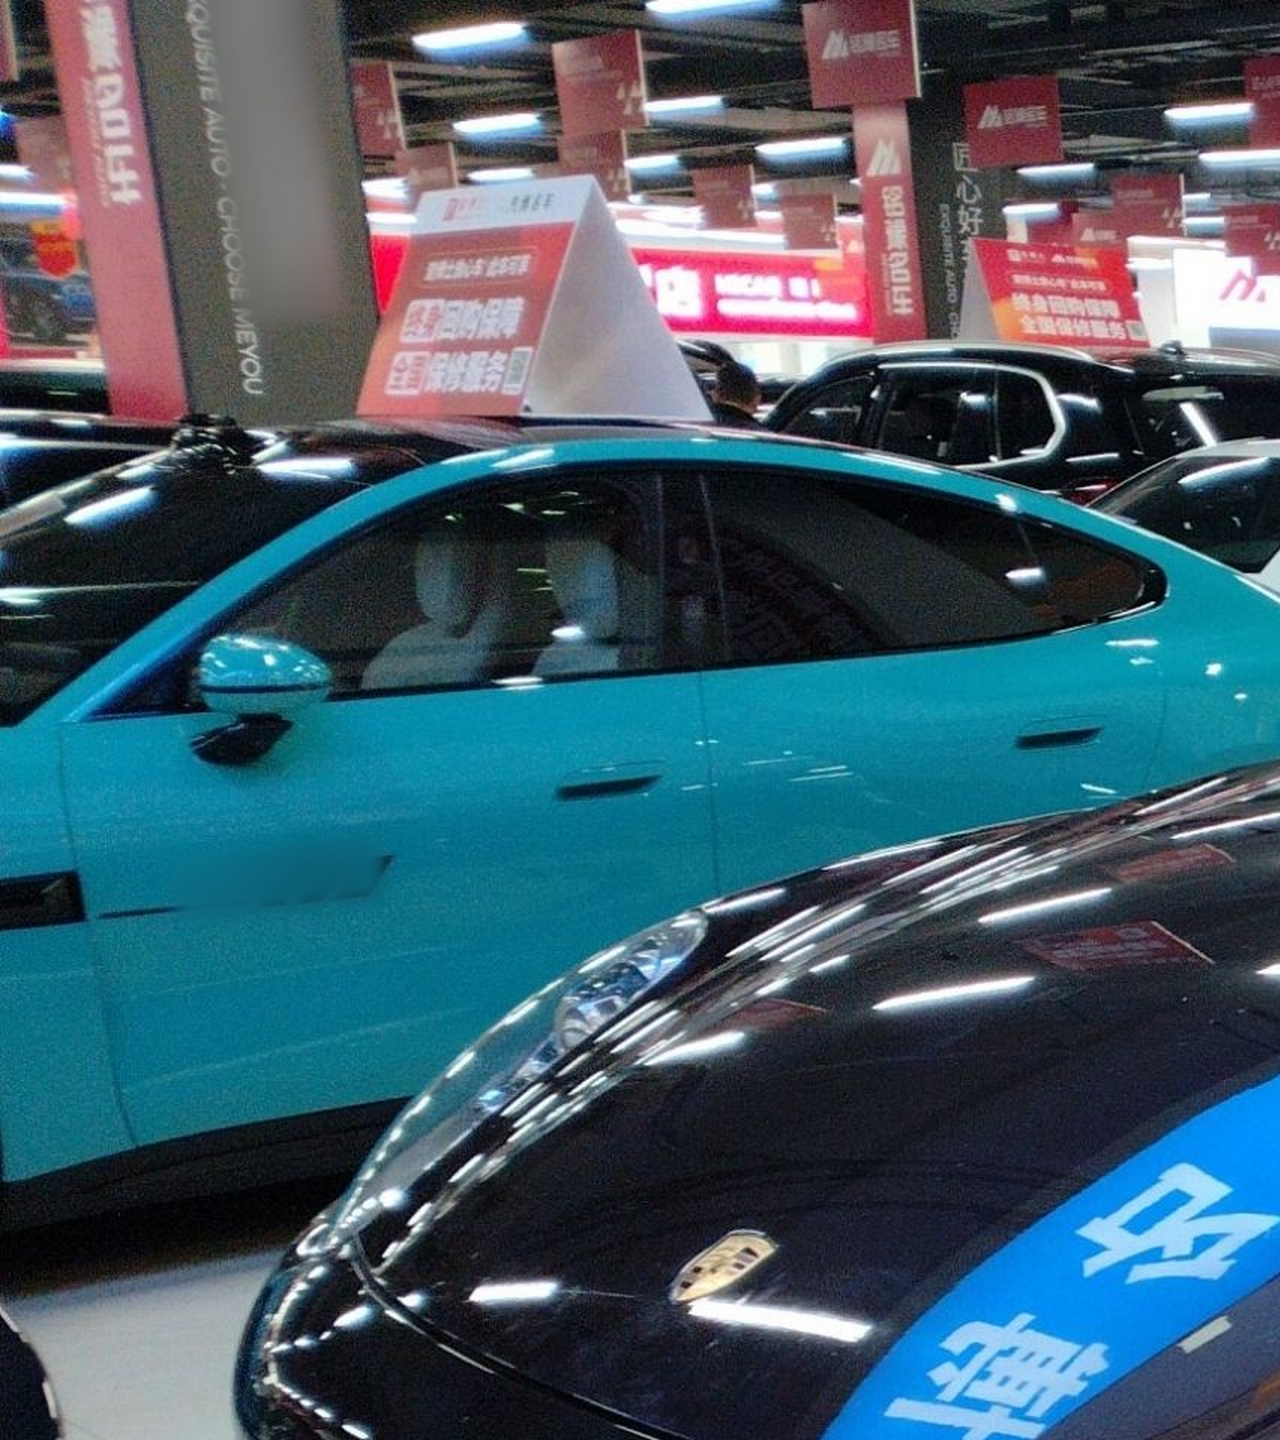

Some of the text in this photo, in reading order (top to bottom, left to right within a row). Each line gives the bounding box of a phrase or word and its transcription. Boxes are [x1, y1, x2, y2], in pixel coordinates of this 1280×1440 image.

[184, 0, 222, 103] QUISITE
[202, 110, 232, 178] AUTO
[217, 198, 246, 300] CHOOSE
